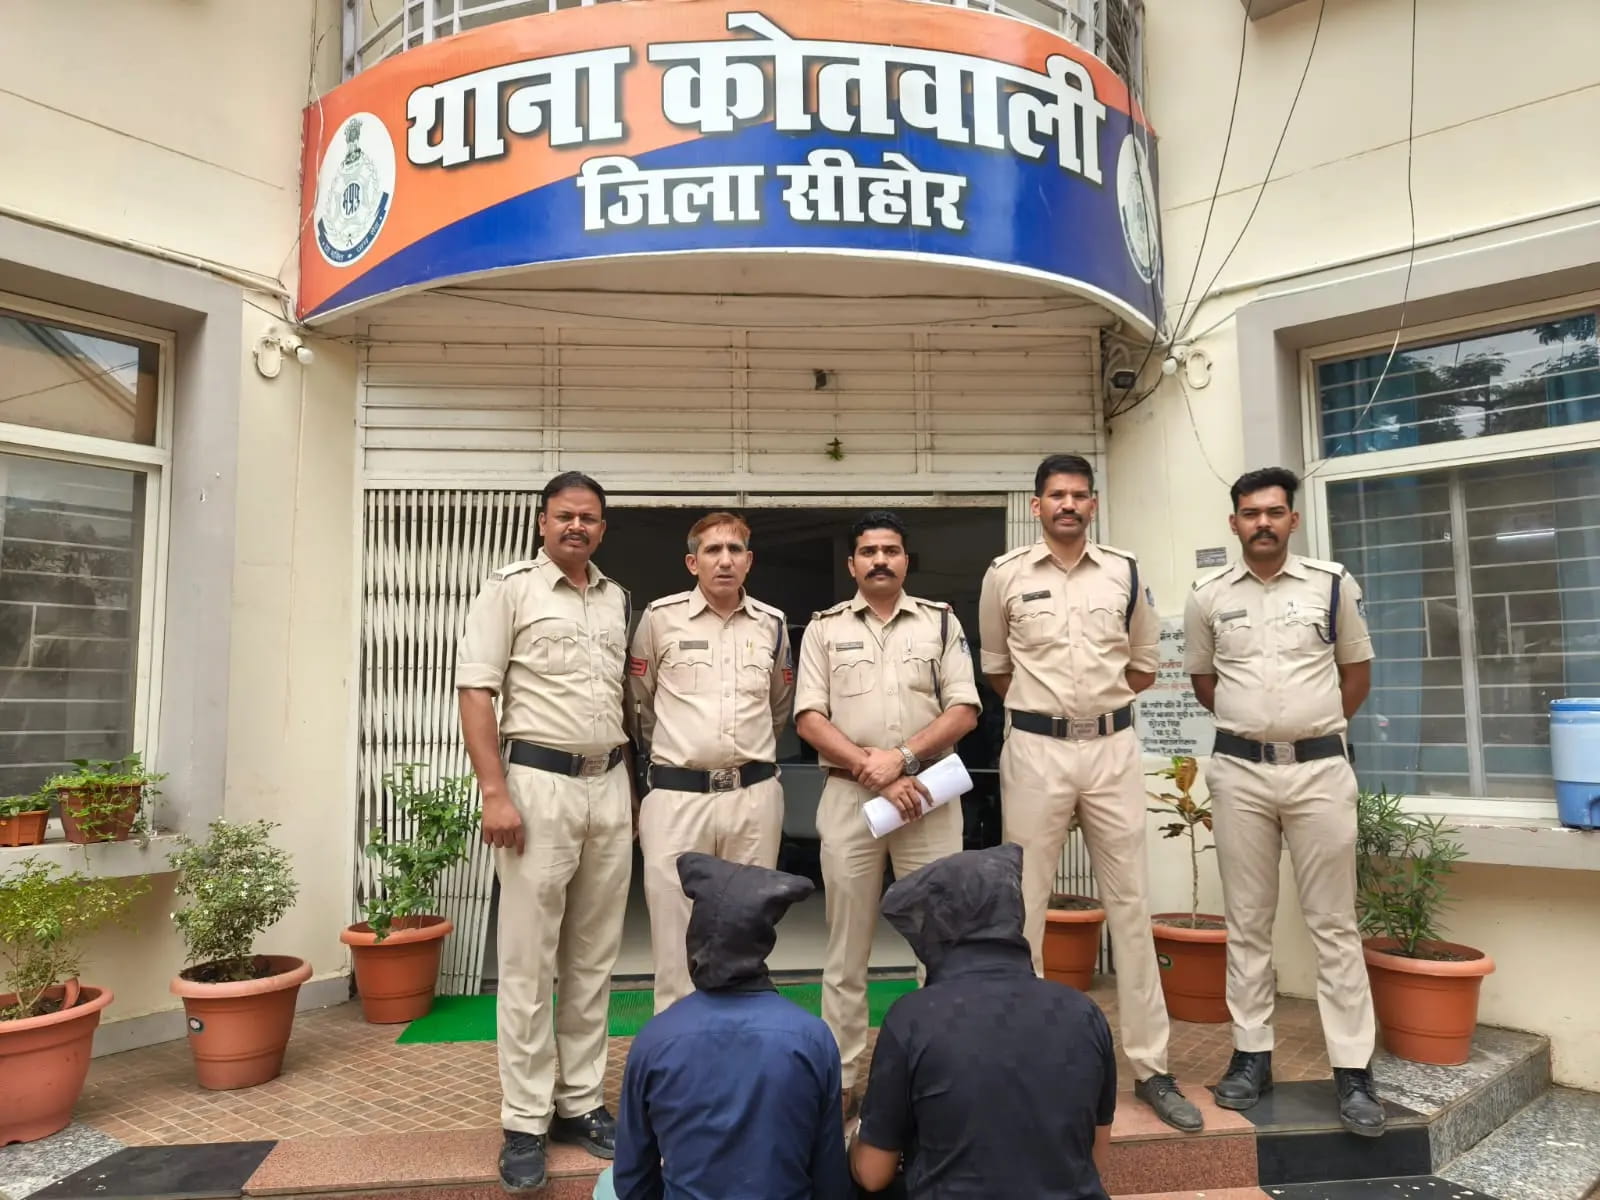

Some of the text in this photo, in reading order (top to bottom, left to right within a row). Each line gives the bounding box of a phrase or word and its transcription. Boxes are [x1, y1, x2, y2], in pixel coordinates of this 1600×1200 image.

[407, 11, 1105, 184] थाना कोतवाली
[576, 148, 967, 230] जिला सीहोर
